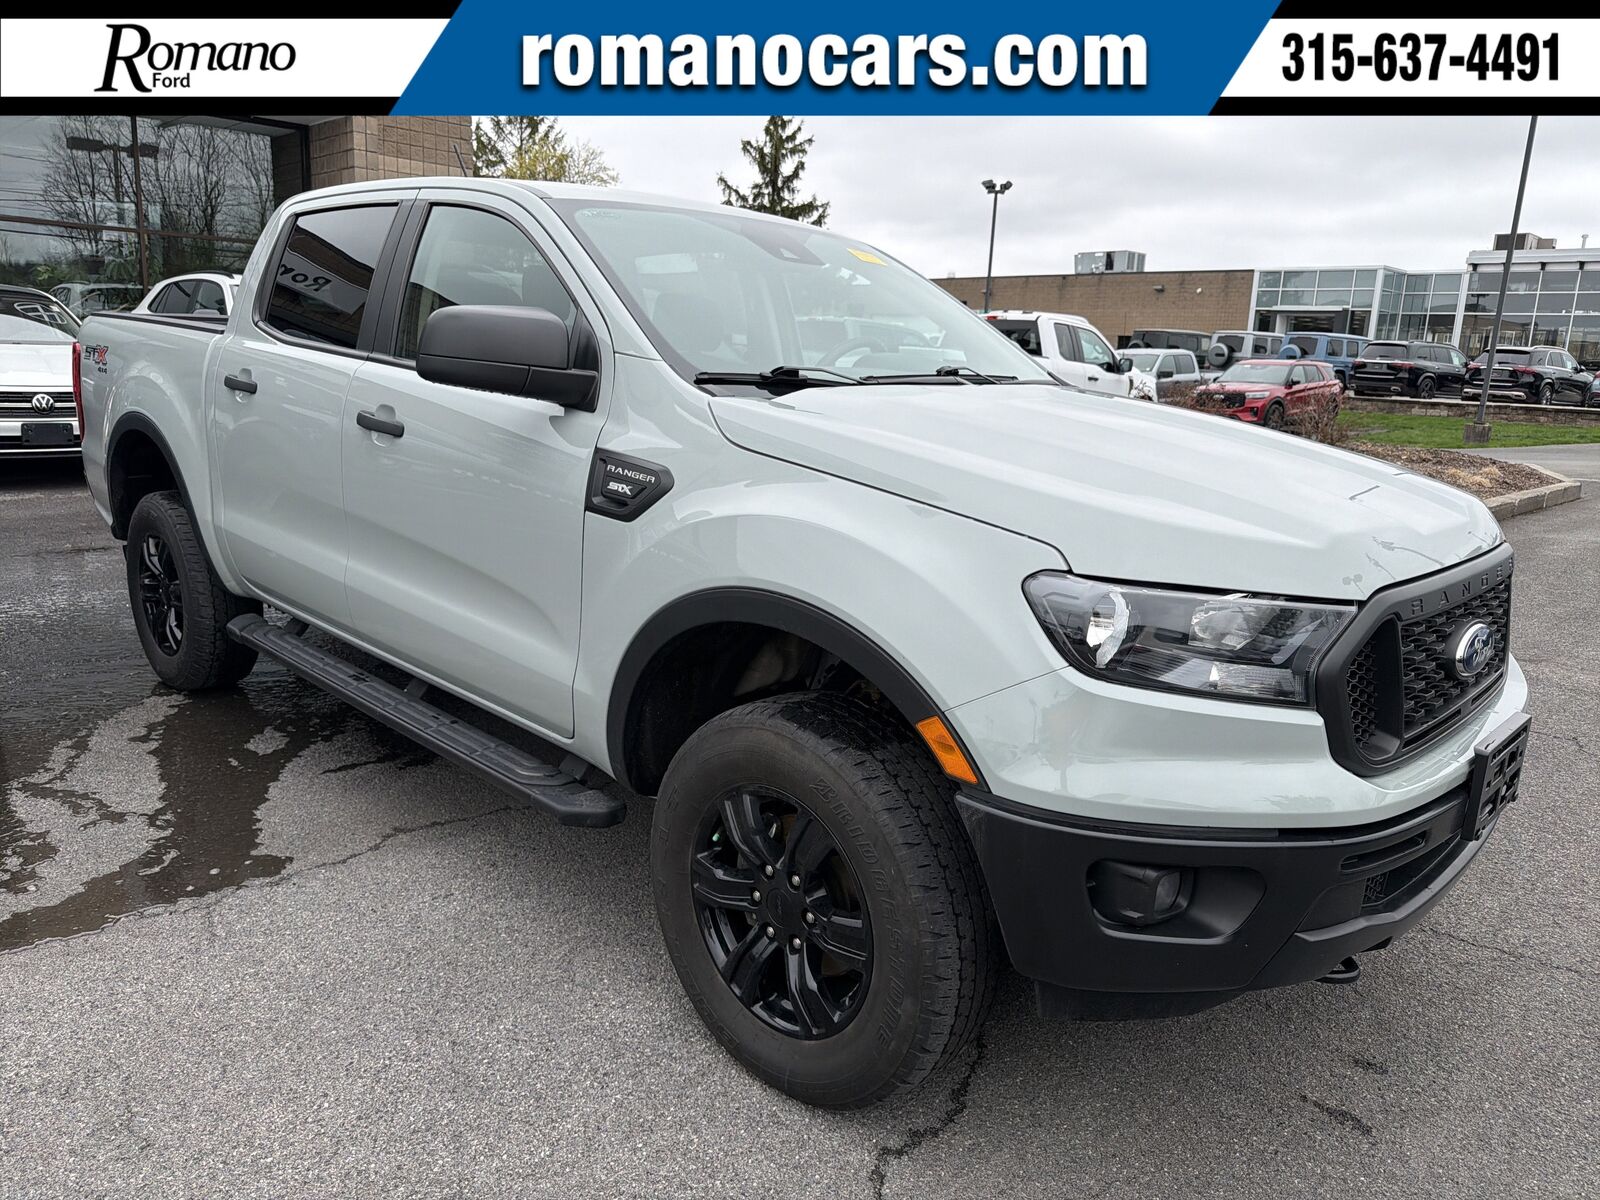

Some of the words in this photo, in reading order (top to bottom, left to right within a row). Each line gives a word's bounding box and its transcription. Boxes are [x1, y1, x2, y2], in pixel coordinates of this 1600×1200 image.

[83, 344, 109, 366] STX
[606, 464, 656, 484] RANGER
[606, 481, 634, 496] STX
[1410, 556, 1515, 617] RANGER
